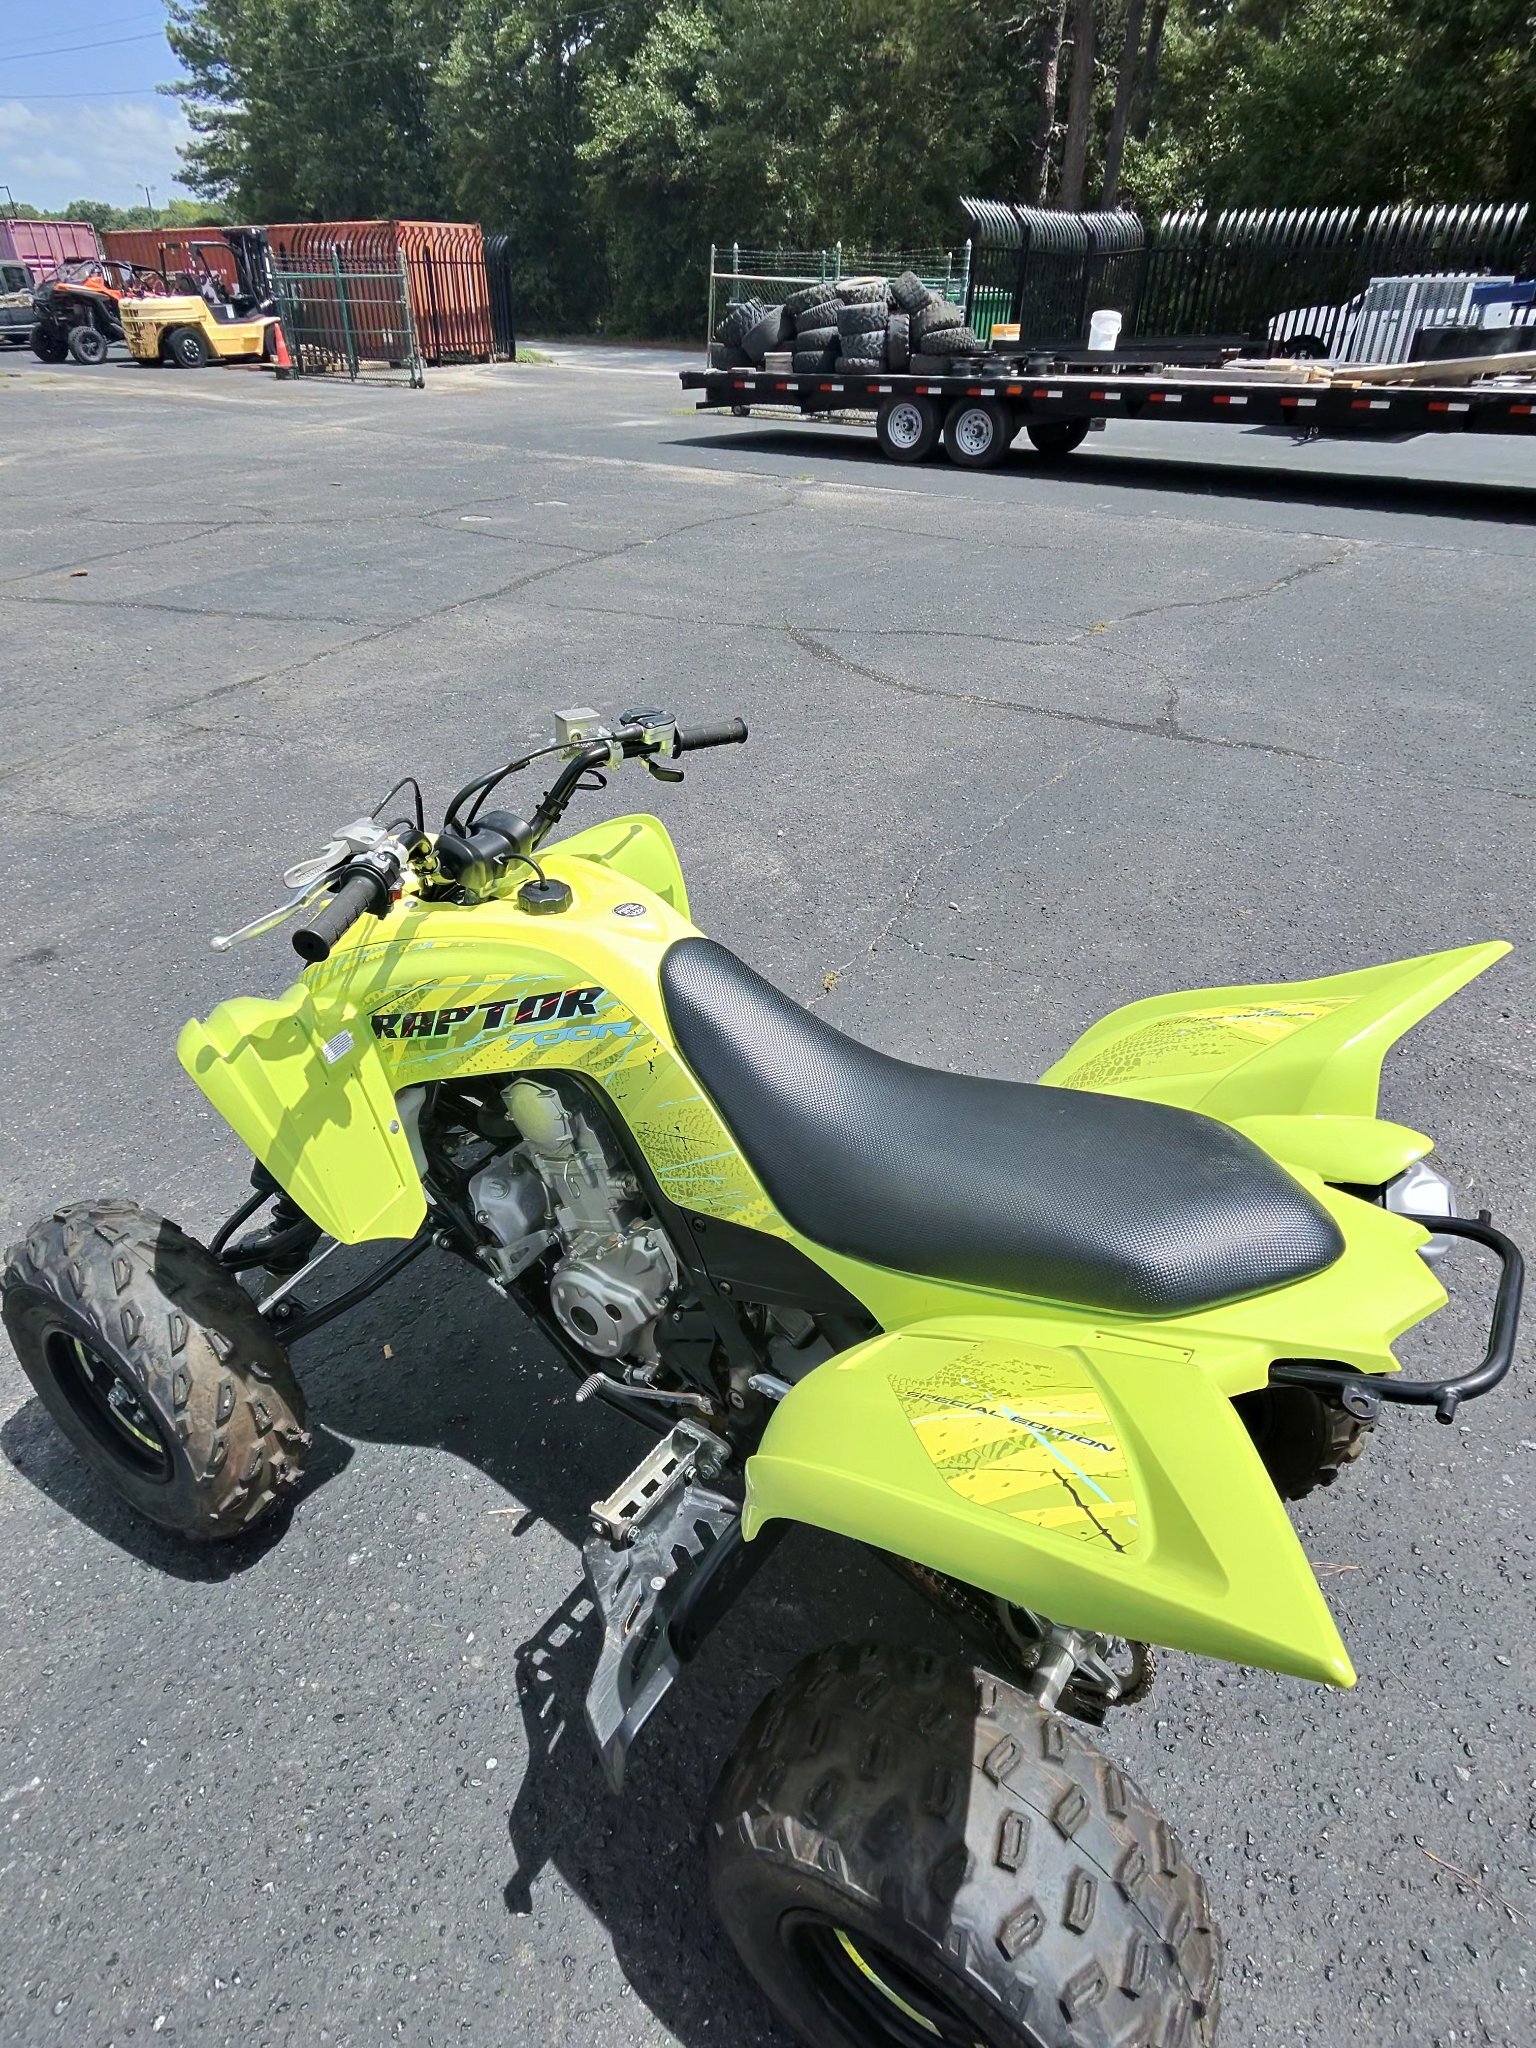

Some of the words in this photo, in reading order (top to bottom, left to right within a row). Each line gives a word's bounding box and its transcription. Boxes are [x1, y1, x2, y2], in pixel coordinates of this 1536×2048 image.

[370, 986, 607, 1039] RAPTOR
[504, 1021, 638, 1051] 700R
[905, 1391, 1004, 1418] SPECIAL
[1010, 1416, 1115, 1451] EDITION
